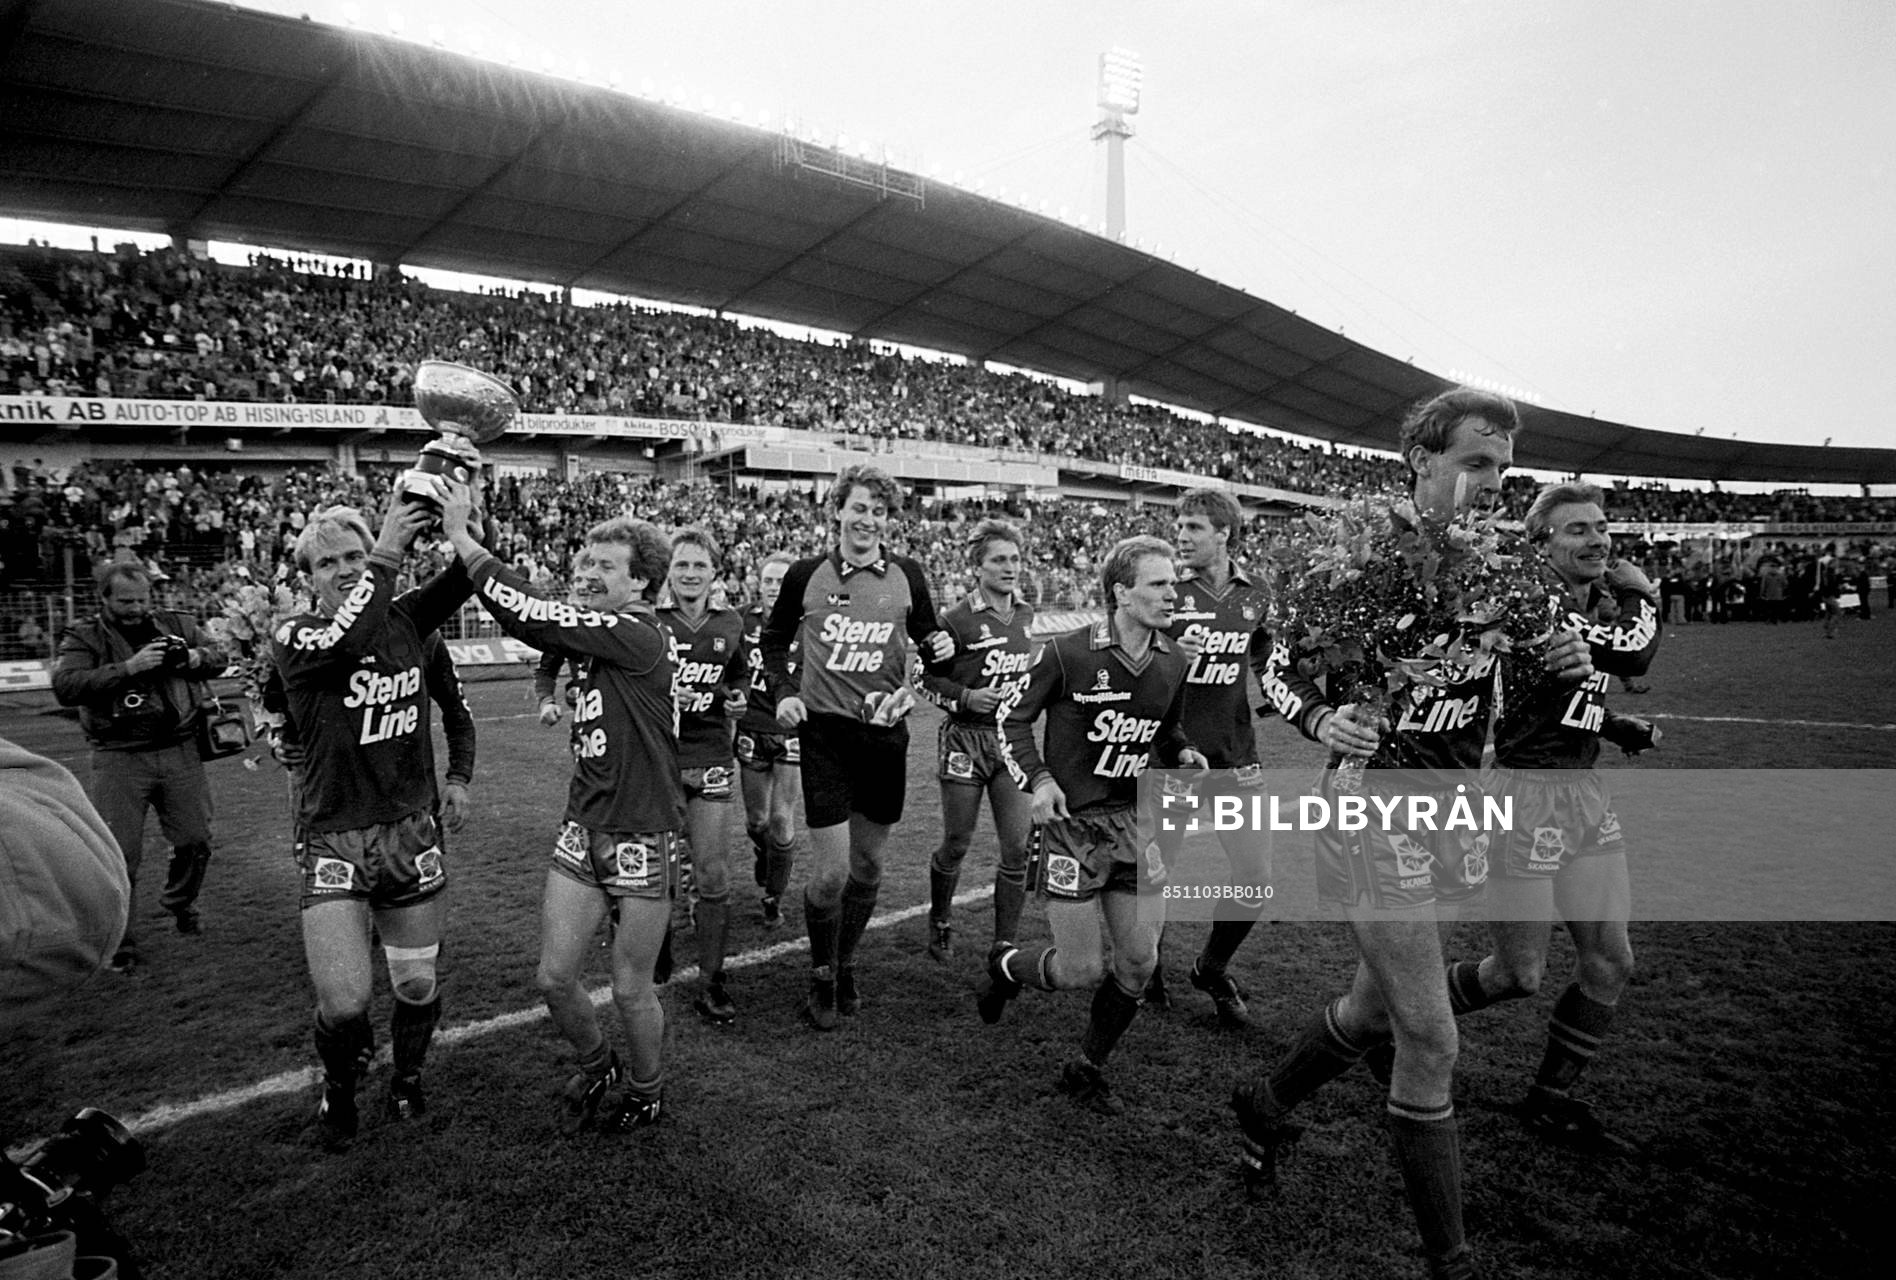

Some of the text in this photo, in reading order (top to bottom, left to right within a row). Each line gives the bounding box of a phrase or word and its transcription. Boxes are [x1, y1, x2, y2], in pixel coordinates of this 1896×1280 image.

[68, 402, 106, 420] AB
[115, 404, 366, 425] AUTO-TOP AB HISING-ISLAND
[820, 613, 895, 643] Stena
[677, 657, 724, 684] tena
[826, 642, 885, 673] Line
[1186, 655, 1241, 685] Line
[344, 666, 421, 708] Stena
[360, 704, 419, 745] Line
[1087, 709, 1162, 744] Stena
[1396, 690, 1480, 733] Line
[1560, 690, 1606, 734] Lin
[1093, 745, 1150, 778] Line
